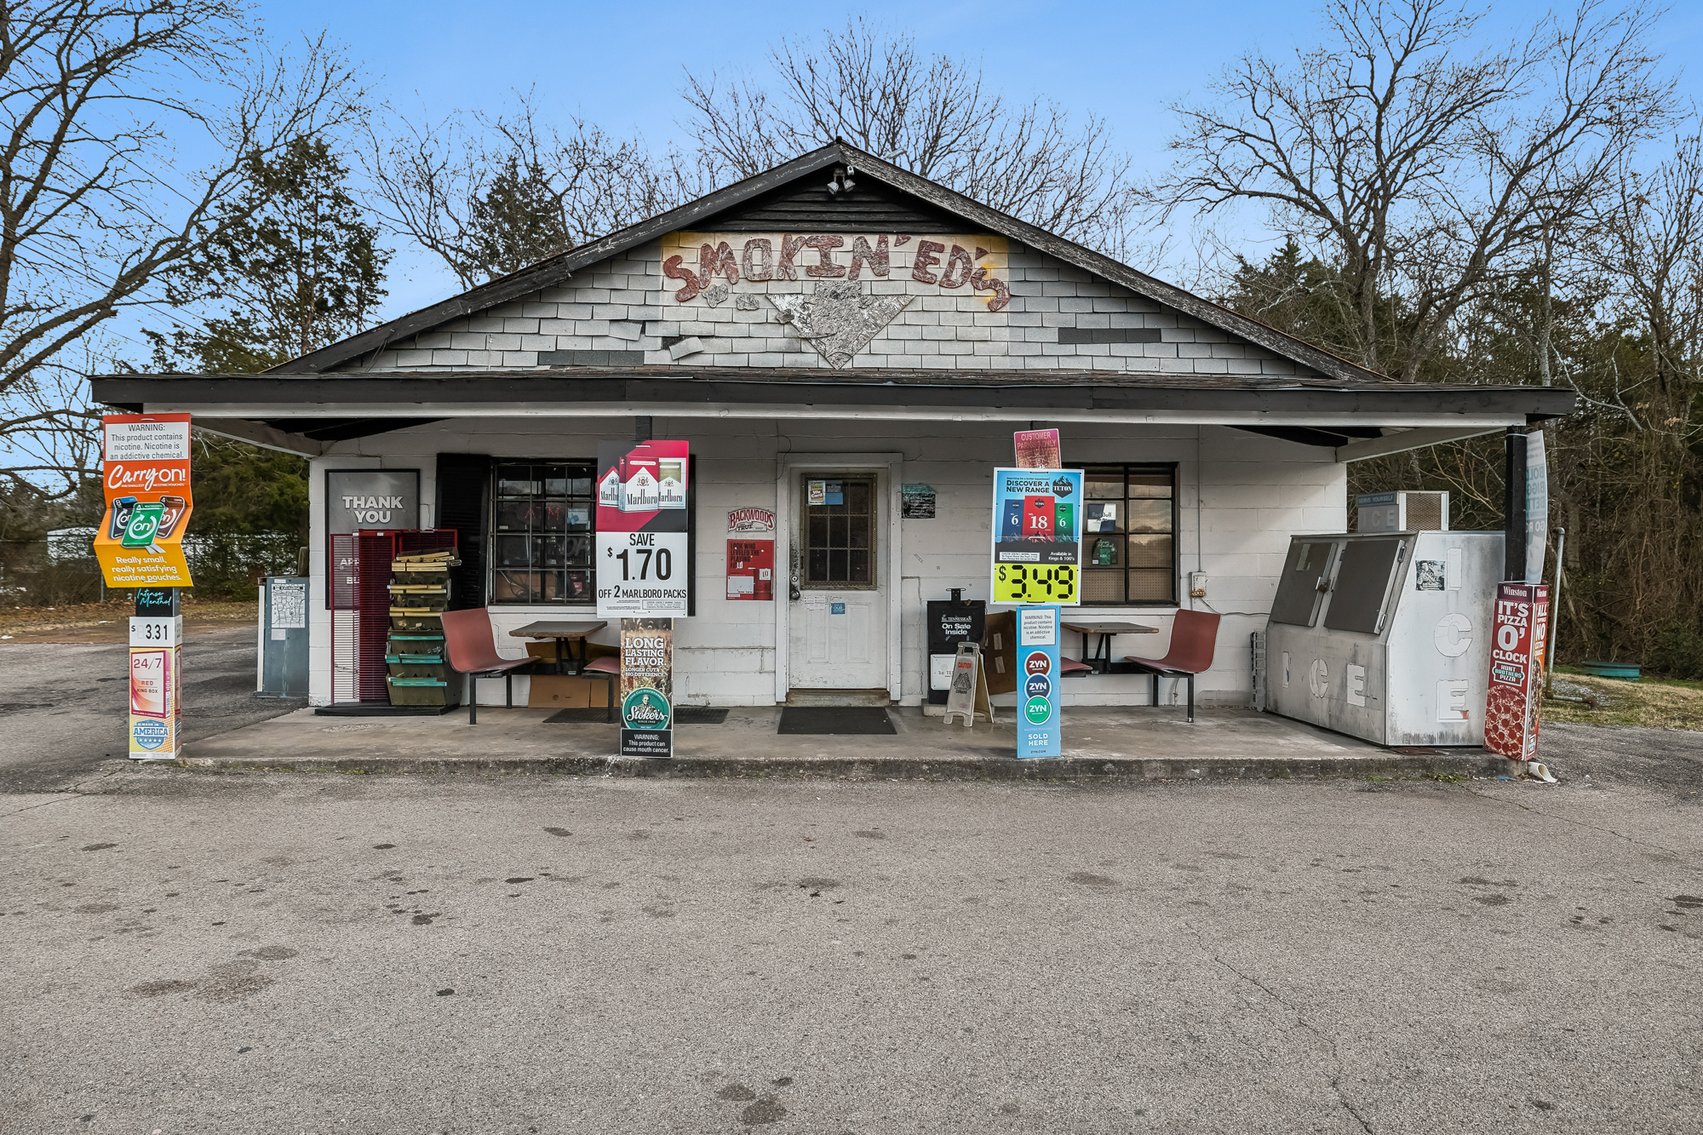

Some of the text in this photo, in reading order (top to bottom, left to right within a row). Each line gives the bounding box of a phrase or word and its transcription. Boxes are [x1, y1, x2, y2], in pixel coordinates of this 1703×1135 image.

[662, 233, 1011, 312] SMOKIN' ED'S
[128, 424, 167, 432] WARNING:
[112, 433, 184, 443] This product contains
[1020, 432, 1052, 441] CUSTOMER
[115, 442, 181, 451] nicotine. Nicotine is
[120, 452, 150, 460] addictive
[151, 451, 184, 459] chemical.
[342, 496, 404, 509] THANK
[627, 488, 659, 505] Marlboro
[354, 510, 391, 523] YOU
[729, 509, 774, 529] BACKWOODS
[1011, 514, 1019, 526] 6
[1030, 515, 1048, 529] 18
[1059, 516, 1067, 527] 6
[630, 533, 655, 547] SAVE
[115, 557, 142, 565] Really
[112, 565, 178, 574] really satisfying
[598, 585, 687, 599] OFF 2 MARLBORO PACKS
[1503, 586, 1527, 598] Winston
[140, 596, 172, 607] Menthol
[1498, 600, 1529, 618] IT'S
[1537, 602, 1547, 616] ALL
[1497, 615, 1528, 627] PIZZA
[145, 624, 168, 641] 3.31
[1535, 623, 1546, 640] NO
[625, 638, 664, 649] LONG
[1497, 625, 1526, 651] O'
[625, 657, 667, 666] FLAVOR.
[1492, 650, 1528, 664] CLOCK
[133, 657, 163, 670] 24/7
[1029, 660, 1047, 669] ZYN
[1494, 669, 1522, 678] BROTHERS
[1029, 682, 1047, 690] ZYN
[627, 705, 668, 721] Stoker's
[1029, 704, 1047, 713] ZYN
[133, 727, 169, 736] AMERICA
